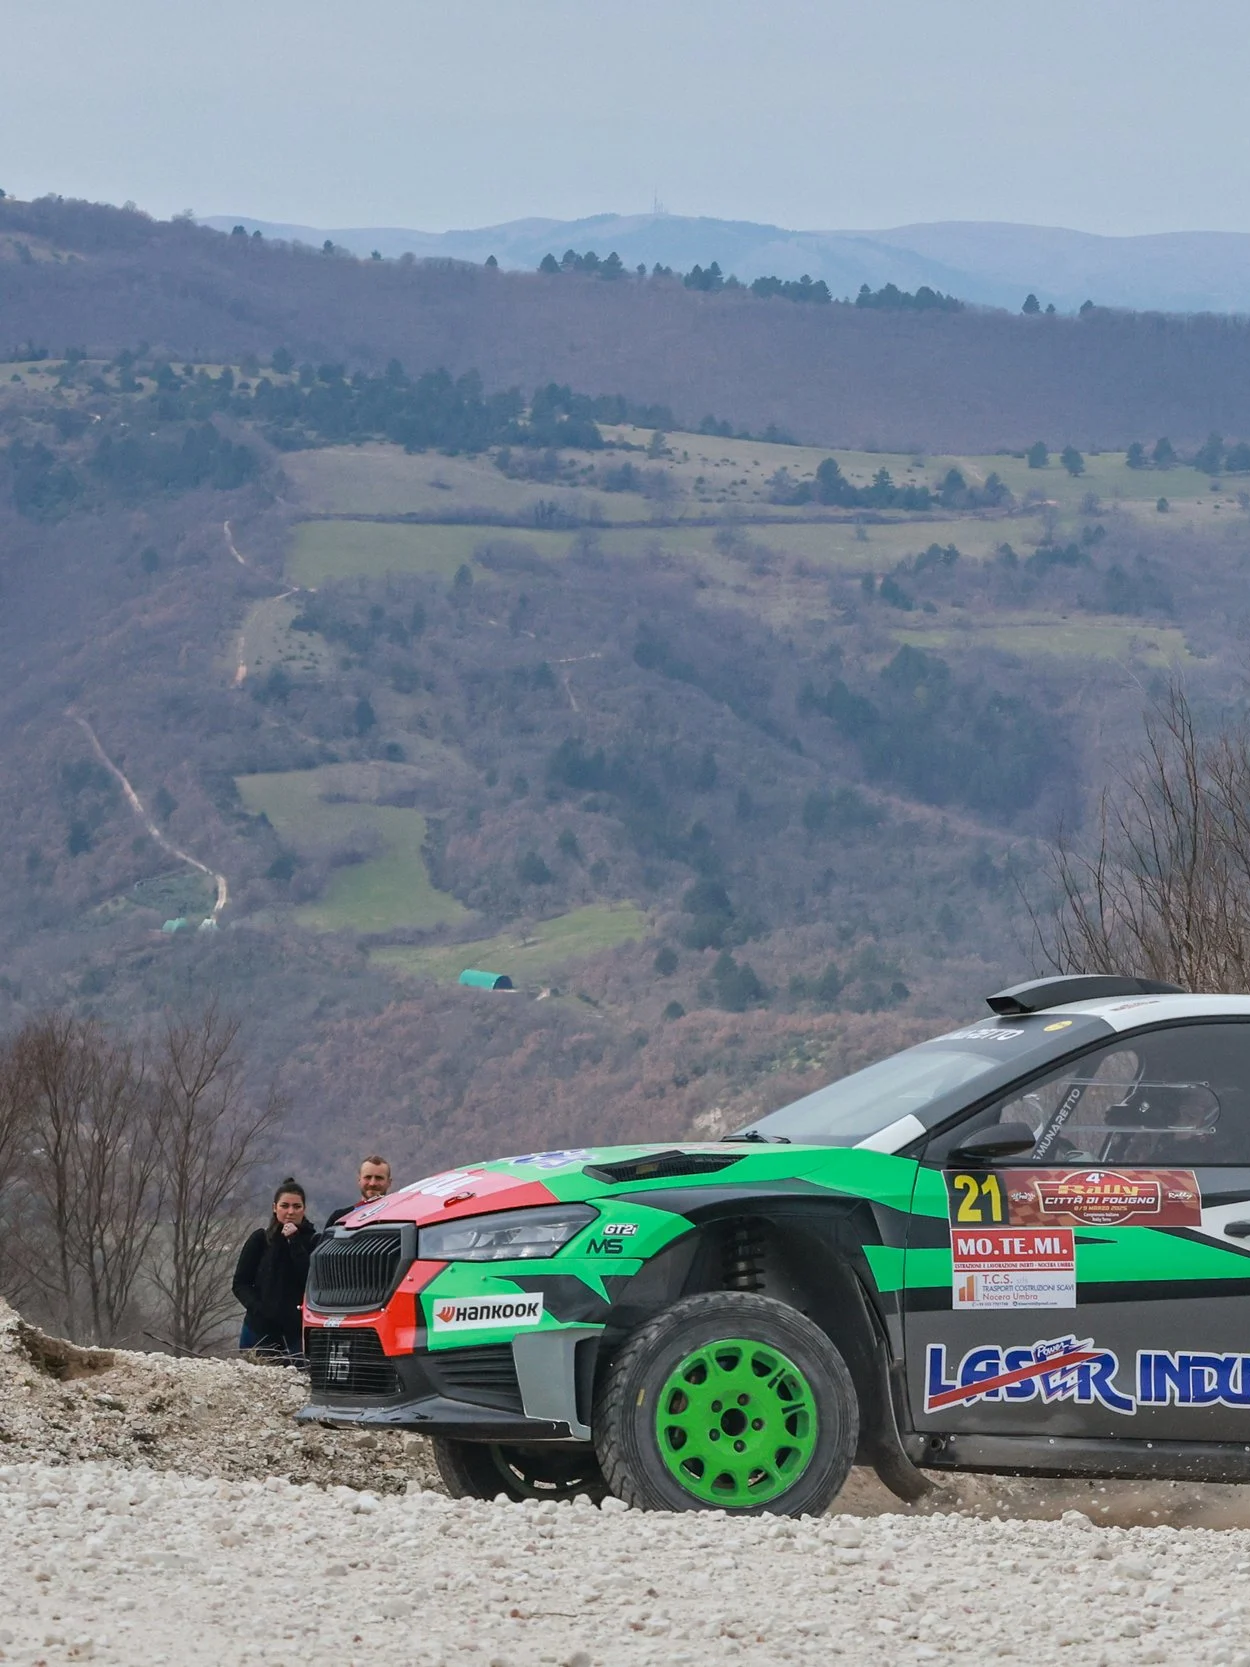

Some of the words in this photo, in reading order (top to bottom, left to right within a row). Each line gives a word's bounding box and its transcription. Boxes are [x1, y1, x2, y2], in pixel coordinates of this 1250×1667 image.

[1036, 1088, 1081, 1157] MUNARETTO
[954, 1174, 1002, 1222] 21
[1057, 1184, 1139, 1197] Rally
[1086, 1196, 1099, 1205] DI
[1101, 1196, 1156, 1205] FOLIGNO
[586, 1238, 624, 1254] MS
[957, 1237, 1068, 1256] MO.TE.MI.
[982, 1274, 1013, 1284] T.C.S.
